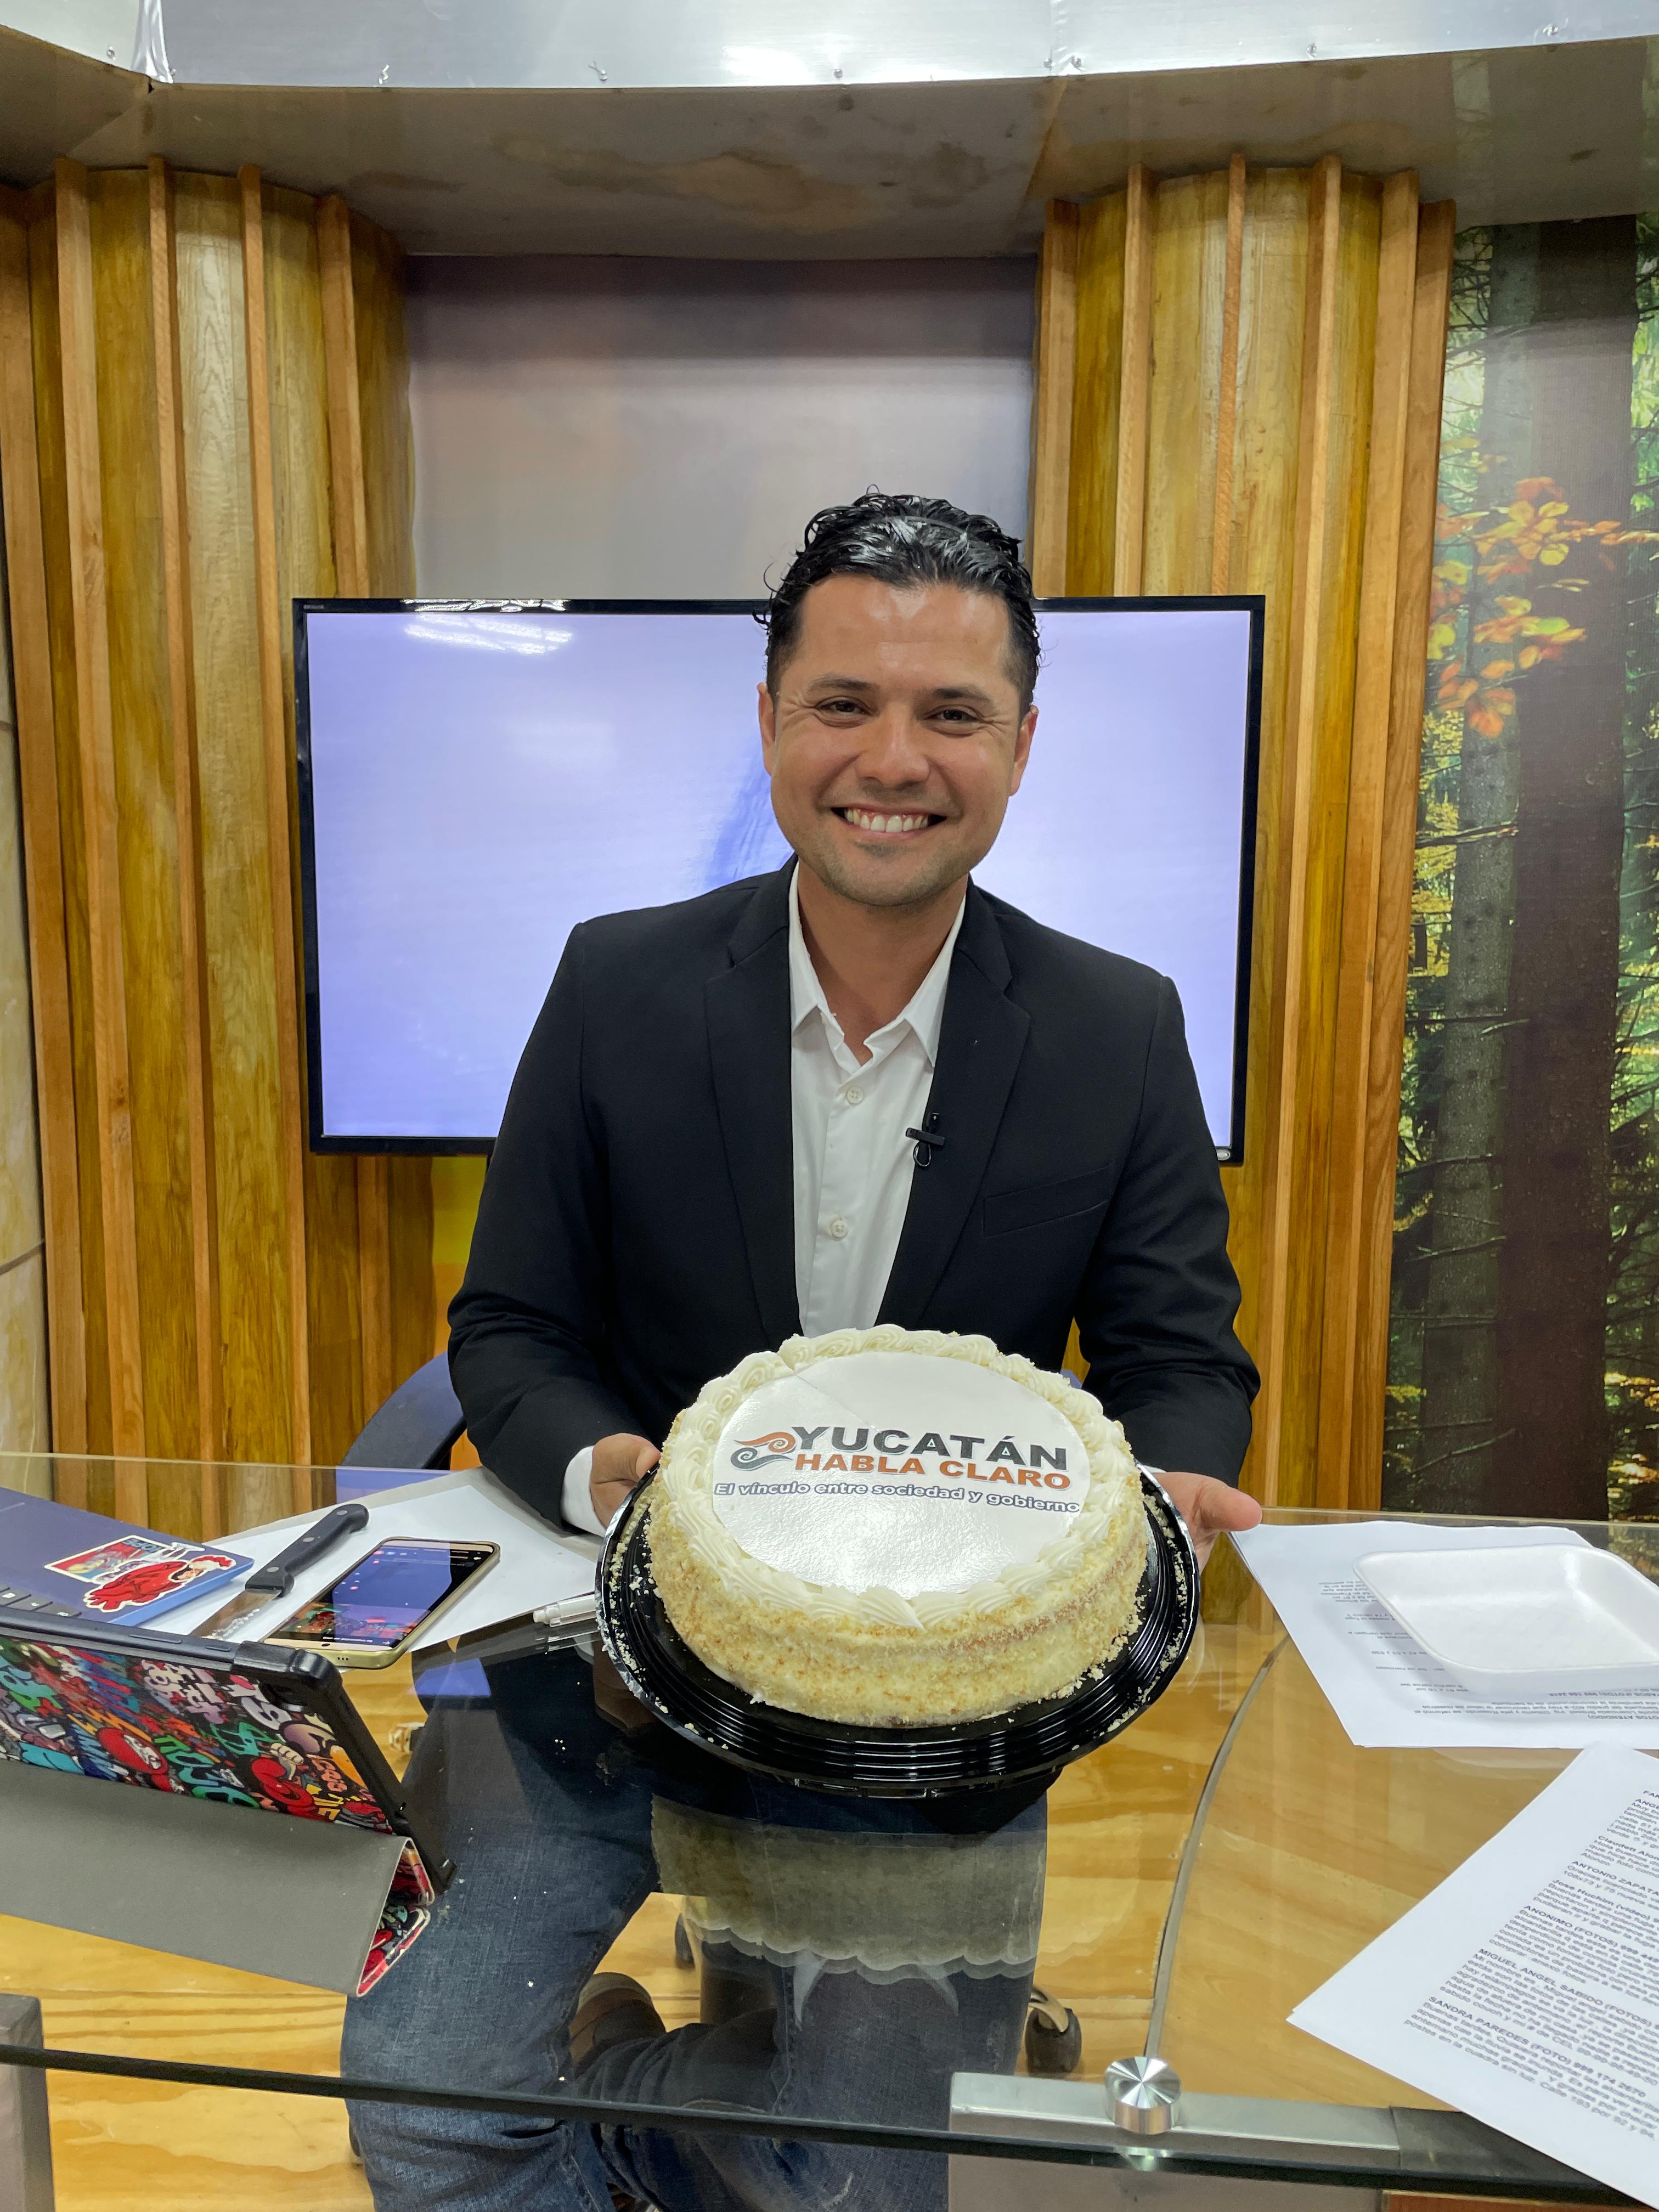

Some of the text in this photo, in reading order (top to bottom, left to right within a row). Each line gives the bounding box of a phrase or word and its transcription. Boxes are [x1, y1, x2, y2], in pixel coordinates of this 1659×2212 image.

[792, 1426, 1067, 1471] YUCATÁN
[795, 1454, 1070, 1489] HABLA CLARO
[714, 1482, 1080, 1513] El vínculo entre sociedad y gobierno
[1572, 1861, 1616, 1879] ANTONIO
[1519, 1910, 1553, 1926] Buenas
[1555, 1925, 1583, 1939] tardes
[1524, 1905, 1572, 1927] ANONIMO
[1479, 1949, 1516, 1968] MIGUEL
[1520, 1968, 1555, 1986] ANGEL
[1560, 1985, 1602, 2005] SABIDO
[1423, 2002, 1458, 2021] Buenas
[1429, 1997, 1472, 2019] SANDRA
[1476, 2018, 1528, 2044] PAREDES
